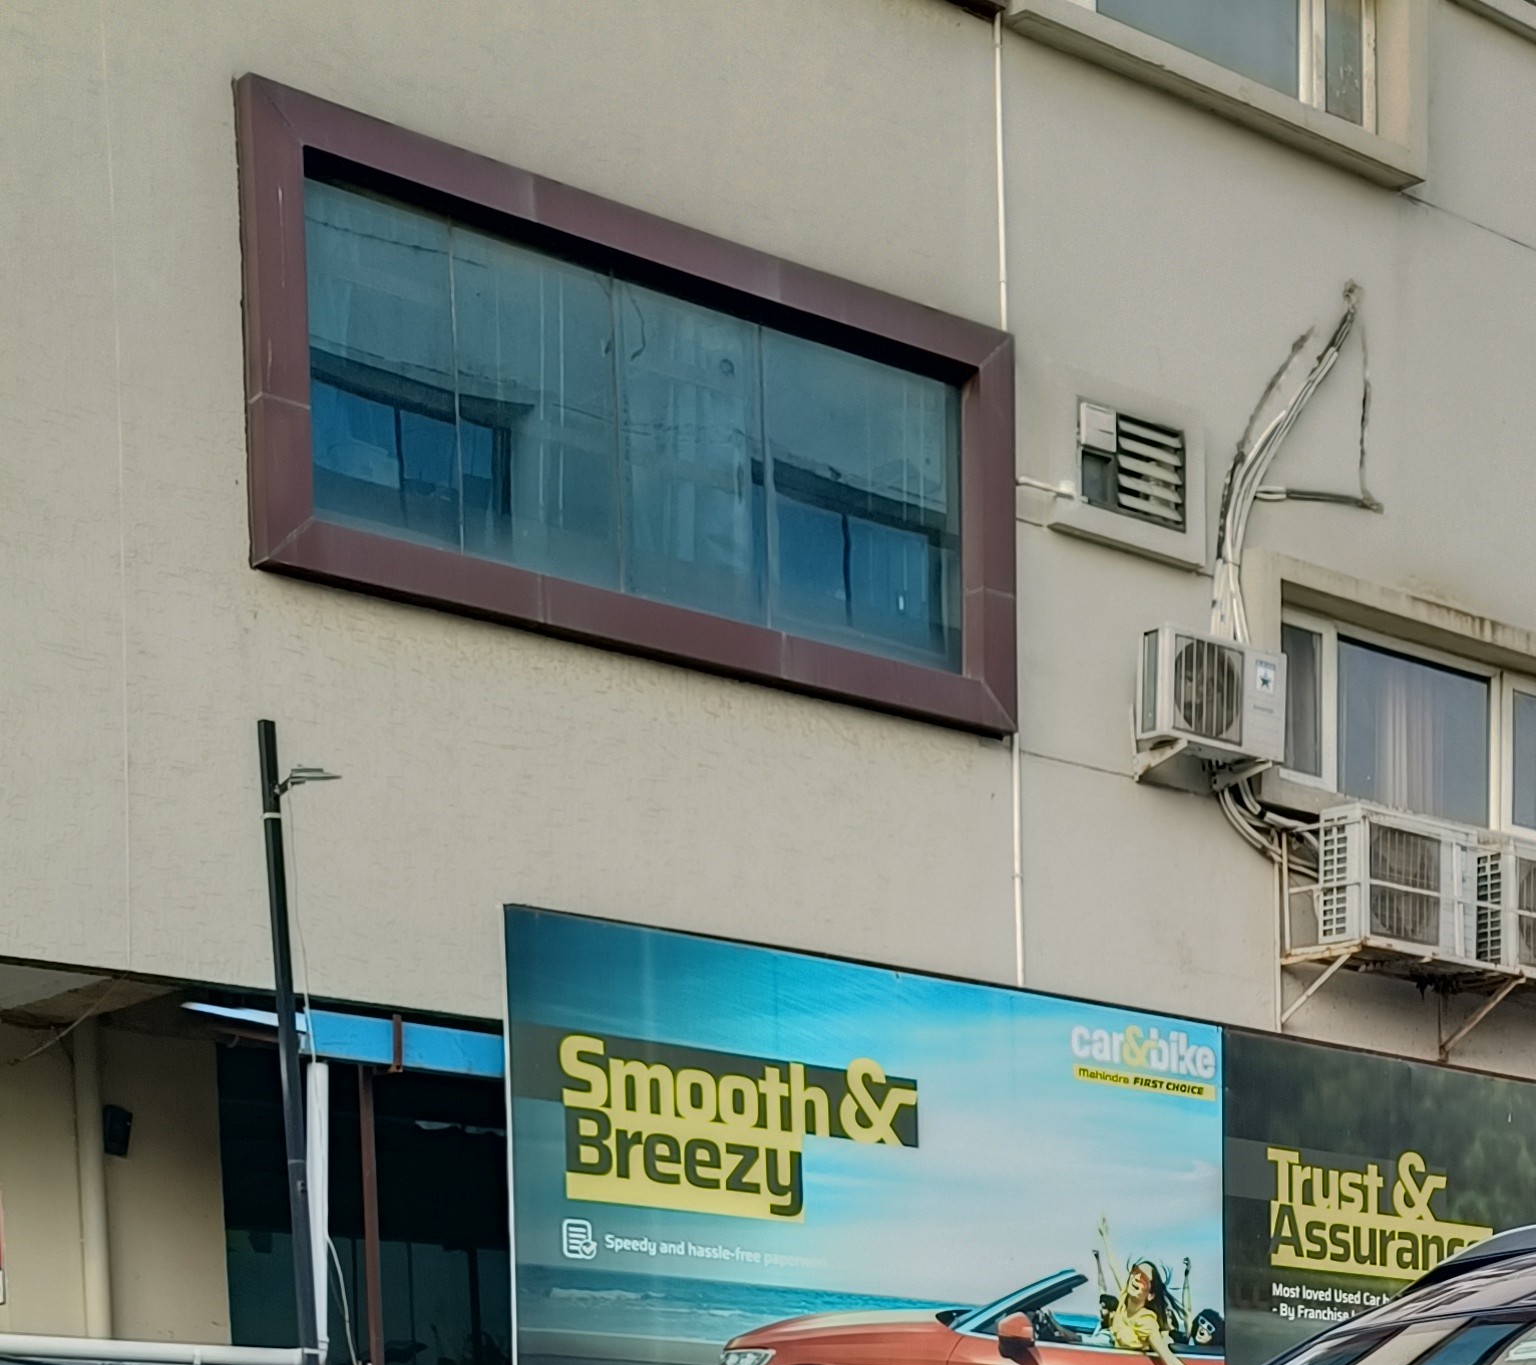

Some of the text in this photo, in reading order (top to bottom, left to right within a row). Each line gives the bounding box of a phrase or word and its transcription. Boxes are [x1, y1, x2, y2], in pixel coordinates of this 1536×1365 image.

[1070, 1024, 1217, 1080] car&bike
[558, 1034, 917, 1146] Smooth &
[1133, 1076, 1164, 1089] FIRST
[1165, 1082, 1205, 1096] CHOICE
[565, 1107, 804, 1218] Breezy
[1267, 1147, 1448, 1221] Trust &
[604, 1233, 657, 1257] Speedy
[659, 1239, 685, 1256] and
[688, 1241, 761, 1263] hassle-free
[1271, 1204, 1480, 1271] Assuranc
[1271, 1282, 1300, 1299] Most
[1302, 1284, 1332, 1302] loved
[1333, 1289, 1361, 1304] Used
[1363, 1292, 1381, 1306] Car
[1279, 1302, 1295, 1321] By
